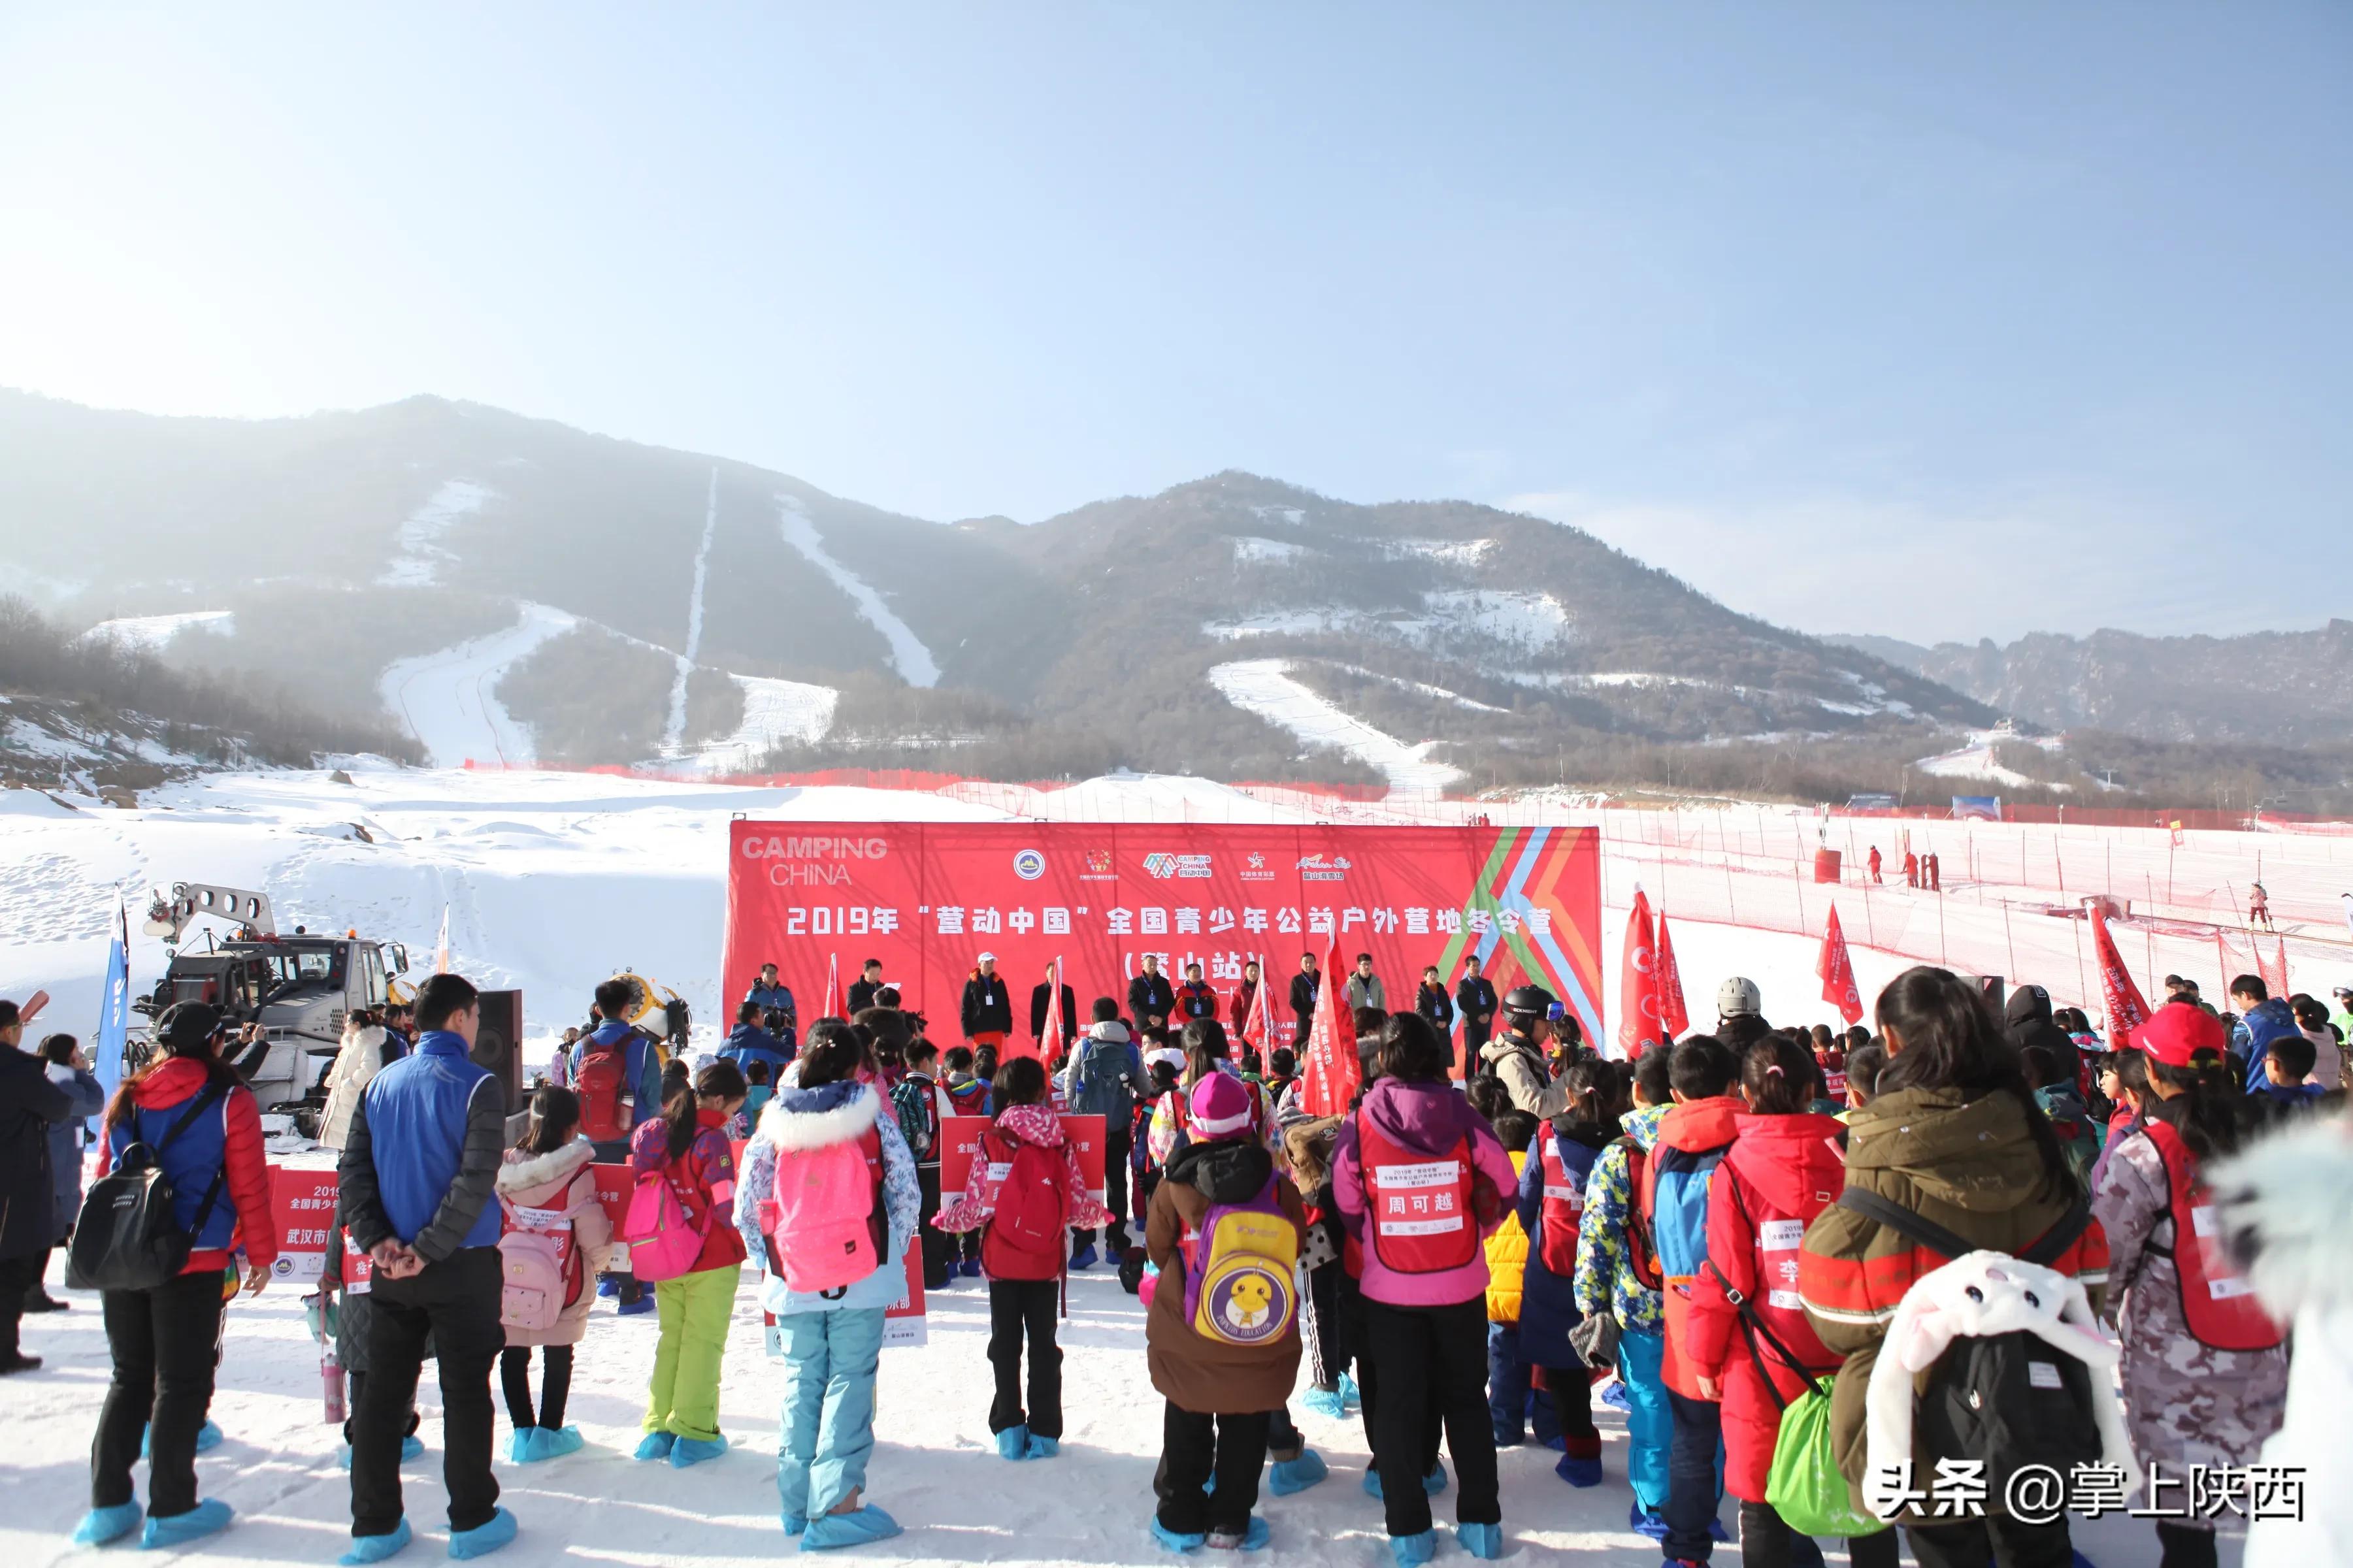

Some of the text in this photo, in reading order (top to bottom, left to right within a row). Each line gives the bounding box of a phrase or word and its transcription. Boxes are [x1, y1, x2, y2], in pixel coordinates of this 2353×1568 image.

[742, 836, 887, 859] CAMPING
[770, 864, 852, 886] CHINA
[1389, 1192, 1453, 1215] 周可越
[287, 1229, 331, 1245] 武汉市
